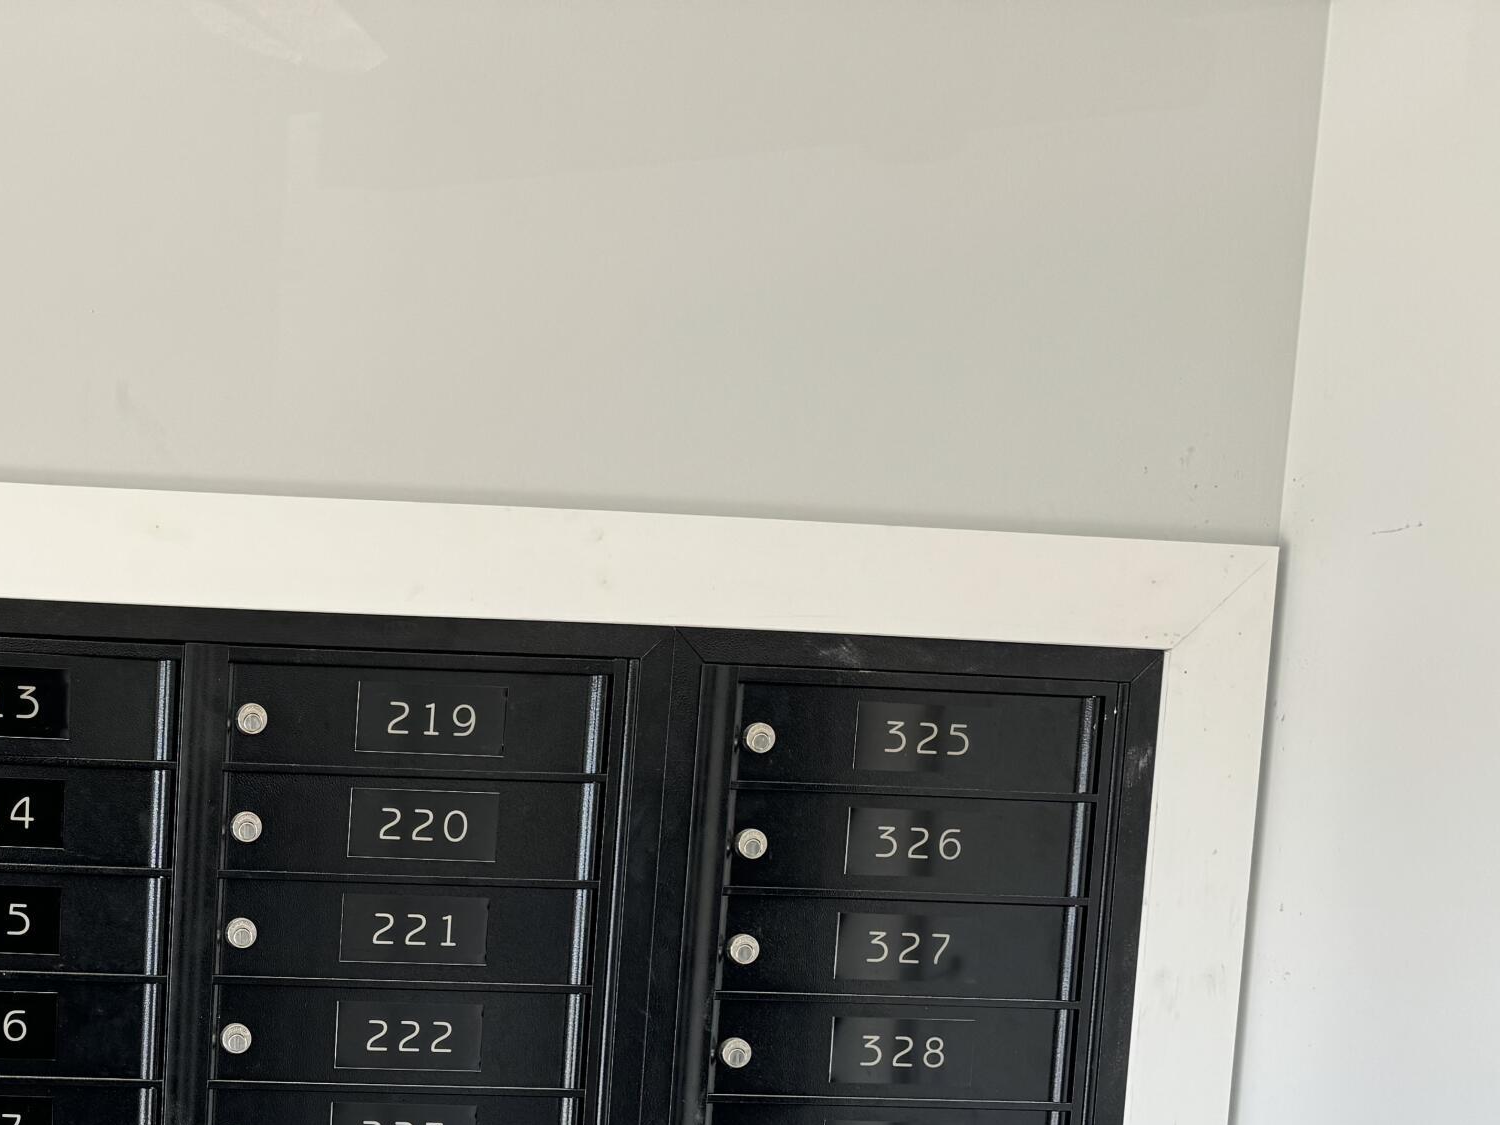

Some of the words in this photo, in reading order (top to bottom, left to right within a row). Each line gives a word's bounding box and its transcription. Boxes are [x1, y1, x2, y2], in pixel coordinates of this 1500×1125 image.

[387, 701, 476, 737] 219
[884, 720, 970, 756] 325
[379, 807, 468, 843] 220
[875, 825, 962, 860] 326
[372, 912, 457, 947] 221
[866, 931, 951, 965] 327
[366, 1019, 453, 1053] 222
[859, 1035, 945, 1068] 328
